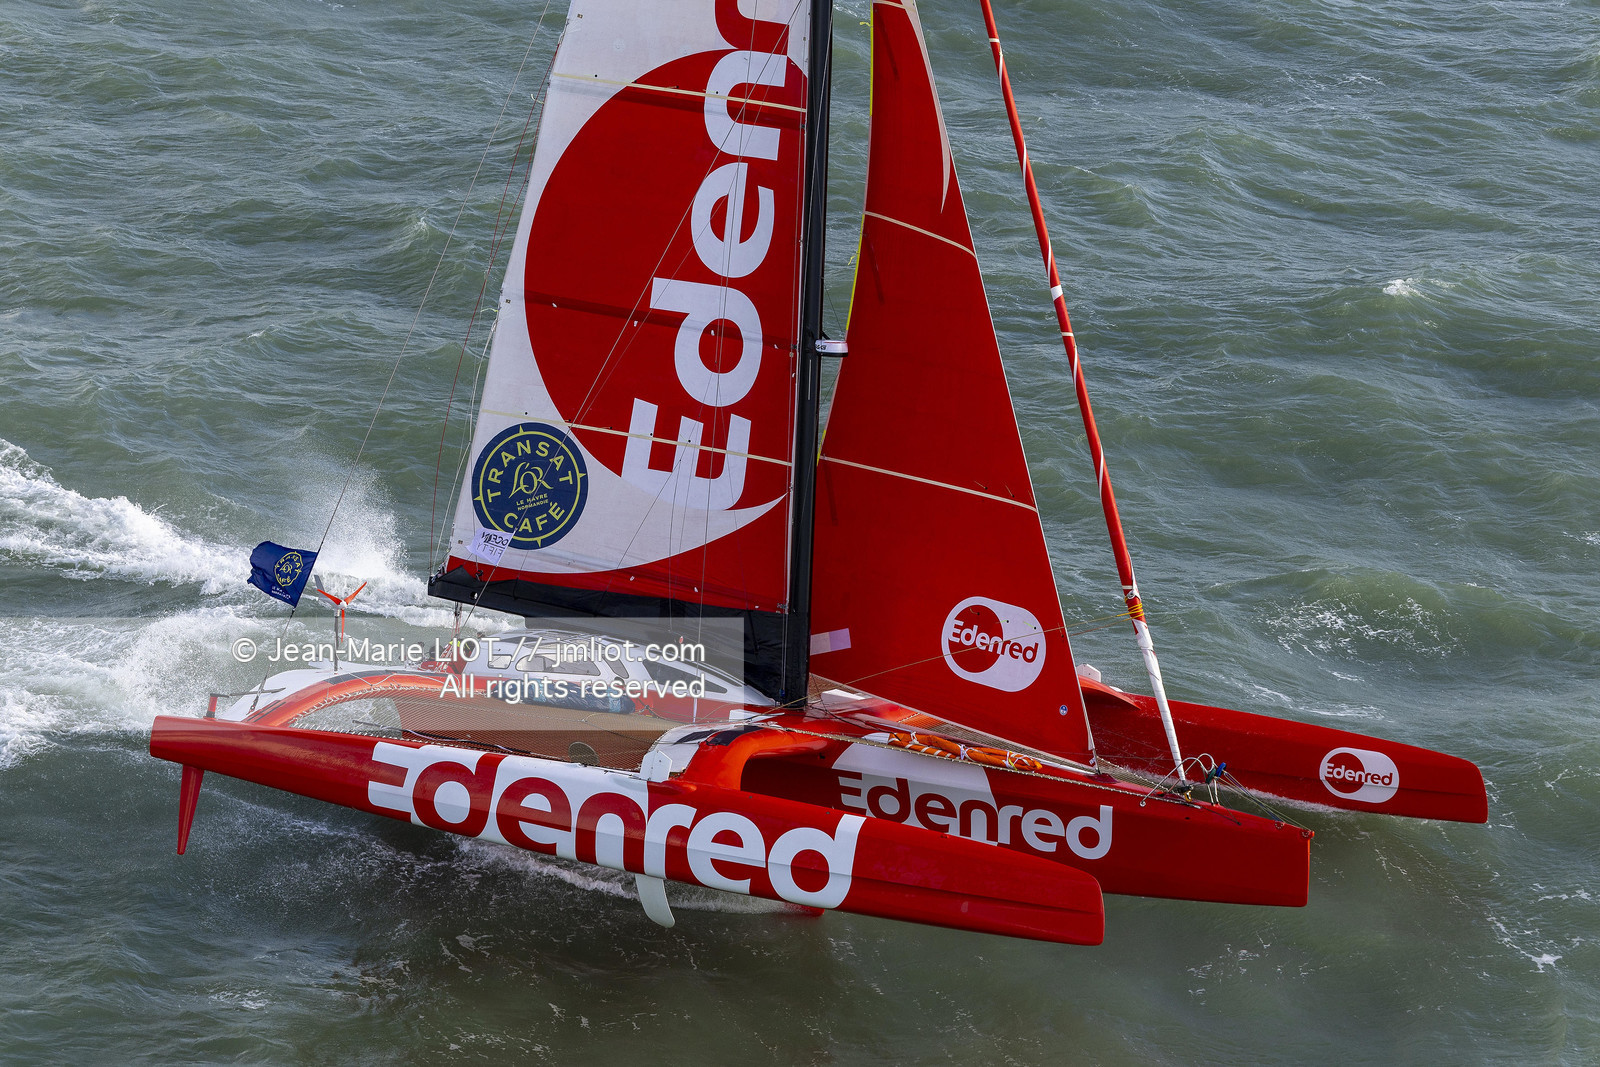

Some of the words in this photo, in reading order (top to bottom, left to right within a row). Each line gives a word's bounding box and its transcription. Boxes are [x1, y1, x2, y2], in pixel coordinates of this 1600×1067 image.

[487, 440, 573, 503] TRANSAT
[508, 462, 555, 498] L'OR
[504, 502, 565, 533] CAFÉ
[526, 493, 548, 503] HAVRE
[949, 619, 1039, 664] Edenred
[1324, 762, 1393, 786] Edenred
[366, 741, 866, 909] Edenred
[837, 771, 1113, 860] Edenred
